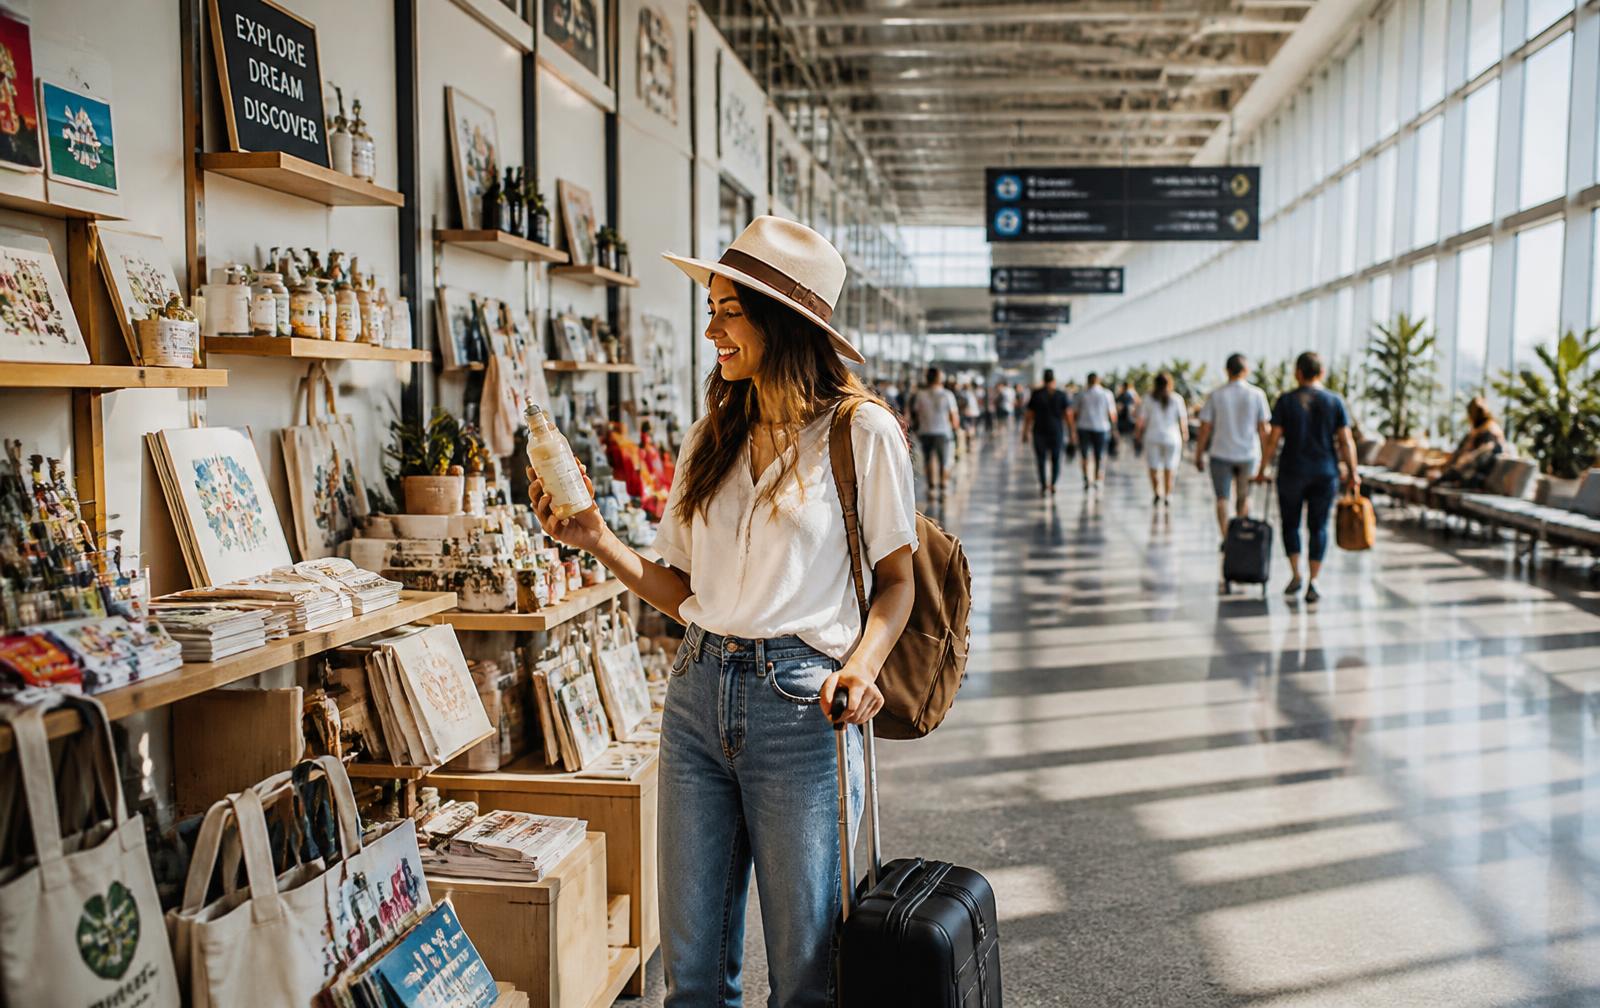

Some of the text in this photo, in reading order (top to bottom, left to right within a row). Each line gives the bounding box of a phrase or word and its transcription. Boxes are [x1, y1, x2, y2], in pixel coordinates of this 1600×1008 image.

[235, 13, 306, 68] EXPLORE
[248, 57, 304, 101] DREAM
[243, 96, 319, 145] DISCOVER
